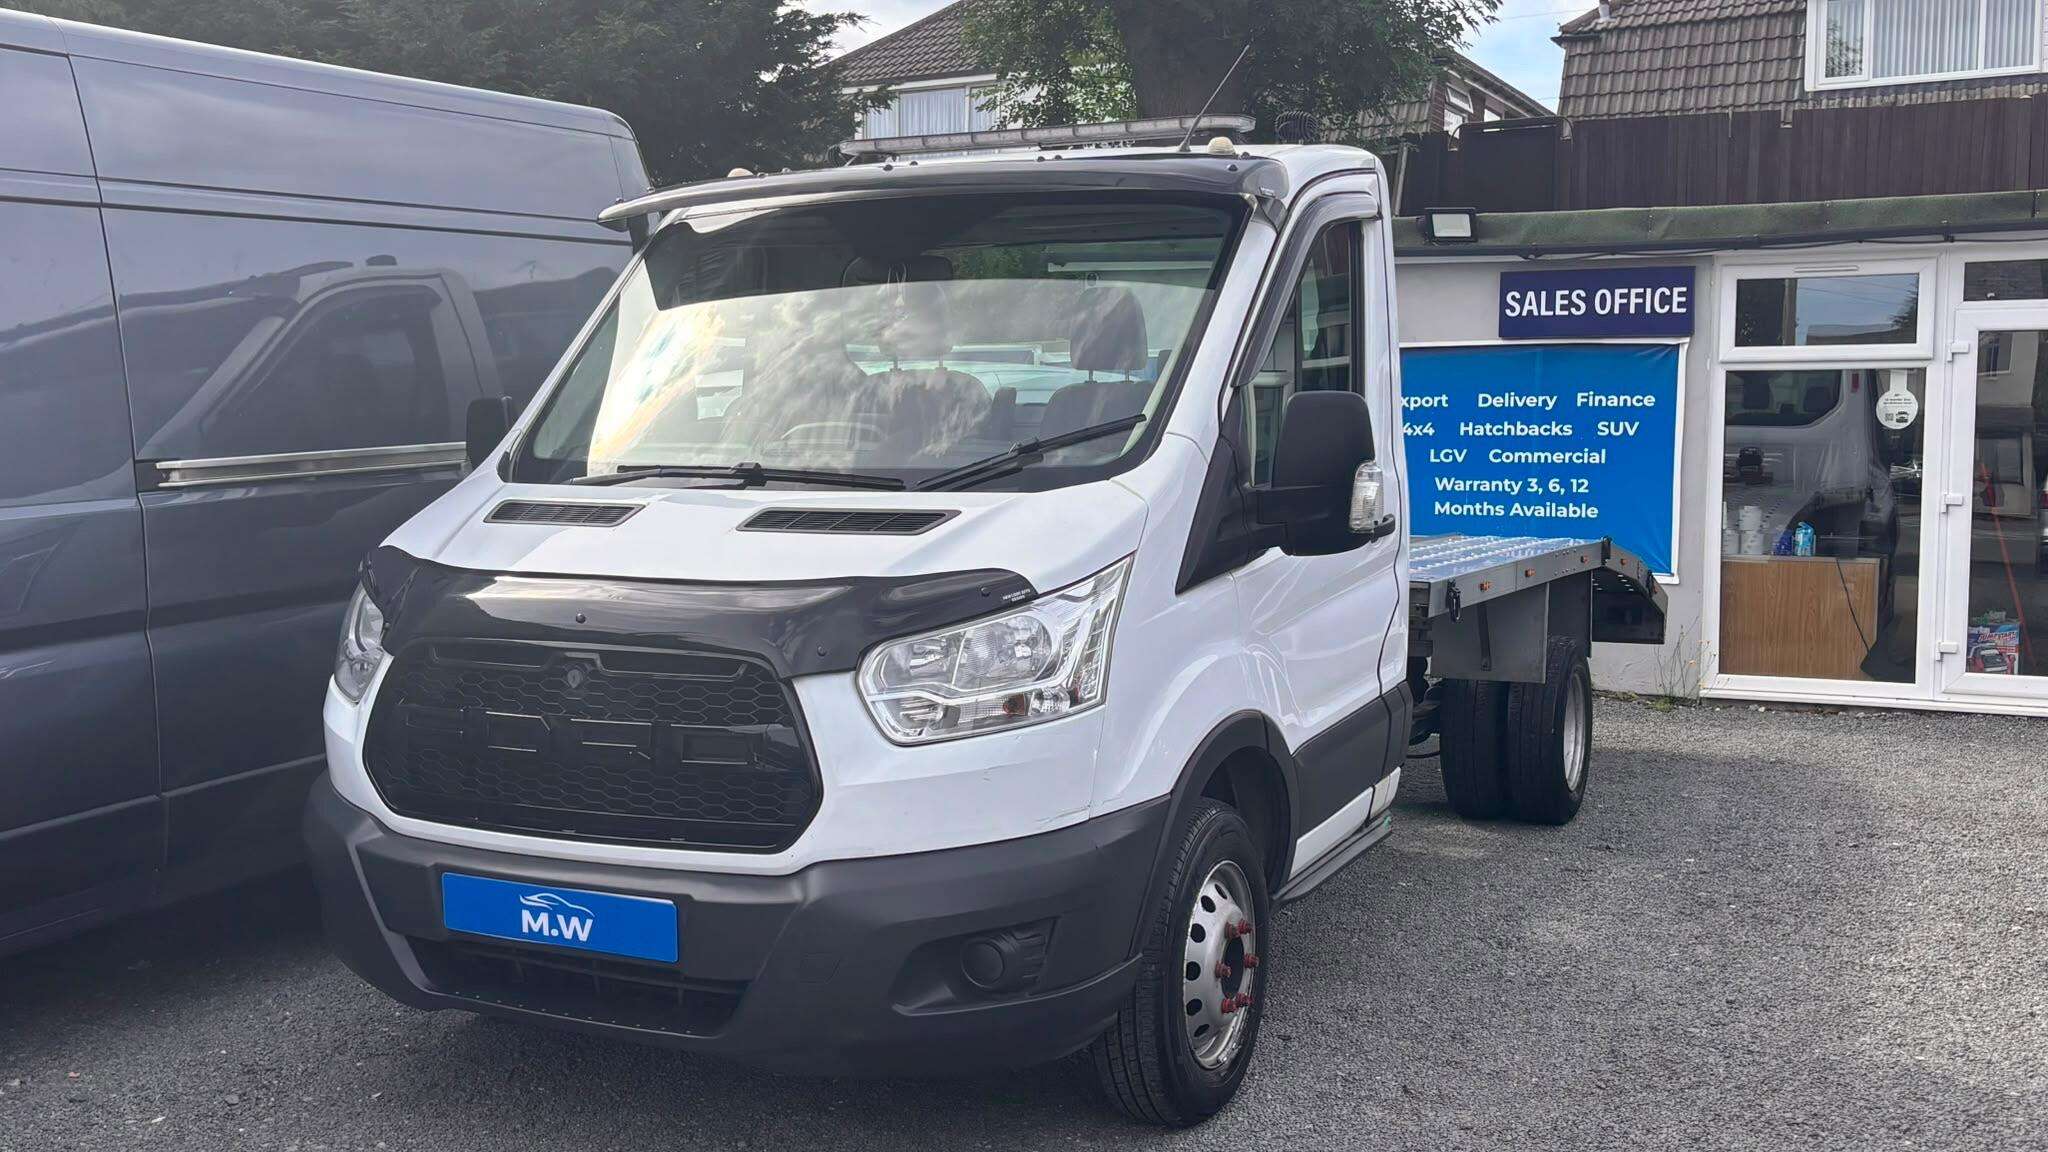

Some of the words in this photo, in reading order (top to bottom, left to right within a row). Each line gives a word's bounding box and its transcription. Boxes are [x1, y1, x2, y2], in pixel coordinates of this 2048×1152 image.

[1504, 289, 1587, 317] SALES
[1594, 286, 1688, 315] OFFICE
[1400, 394, 1448, 411] xport
[1478, 391, 1558, 411] Delivery
[1576, 390, 1656, 407] Finance
[1402, 421, 1436, 436] 4x4
[1459, 421, 1573, 436] Hatchbacks
[1597, 421, 1640, 436] SUV
[1429, 448, 1467, 463] LGV
[1488, 448, 1606, 464] Commercial
[1434, 477, 1521, 495] Warranty
[1527, 478, 1544, 495] 3,
[1548, 478, 1566, 495] 6,
[1570, 478, 1589, 493] 12
[1434, 501, 1505, 516] Months
[1509, 501, 1599, 518] Available
[521, 909, 594, 942] M.W
